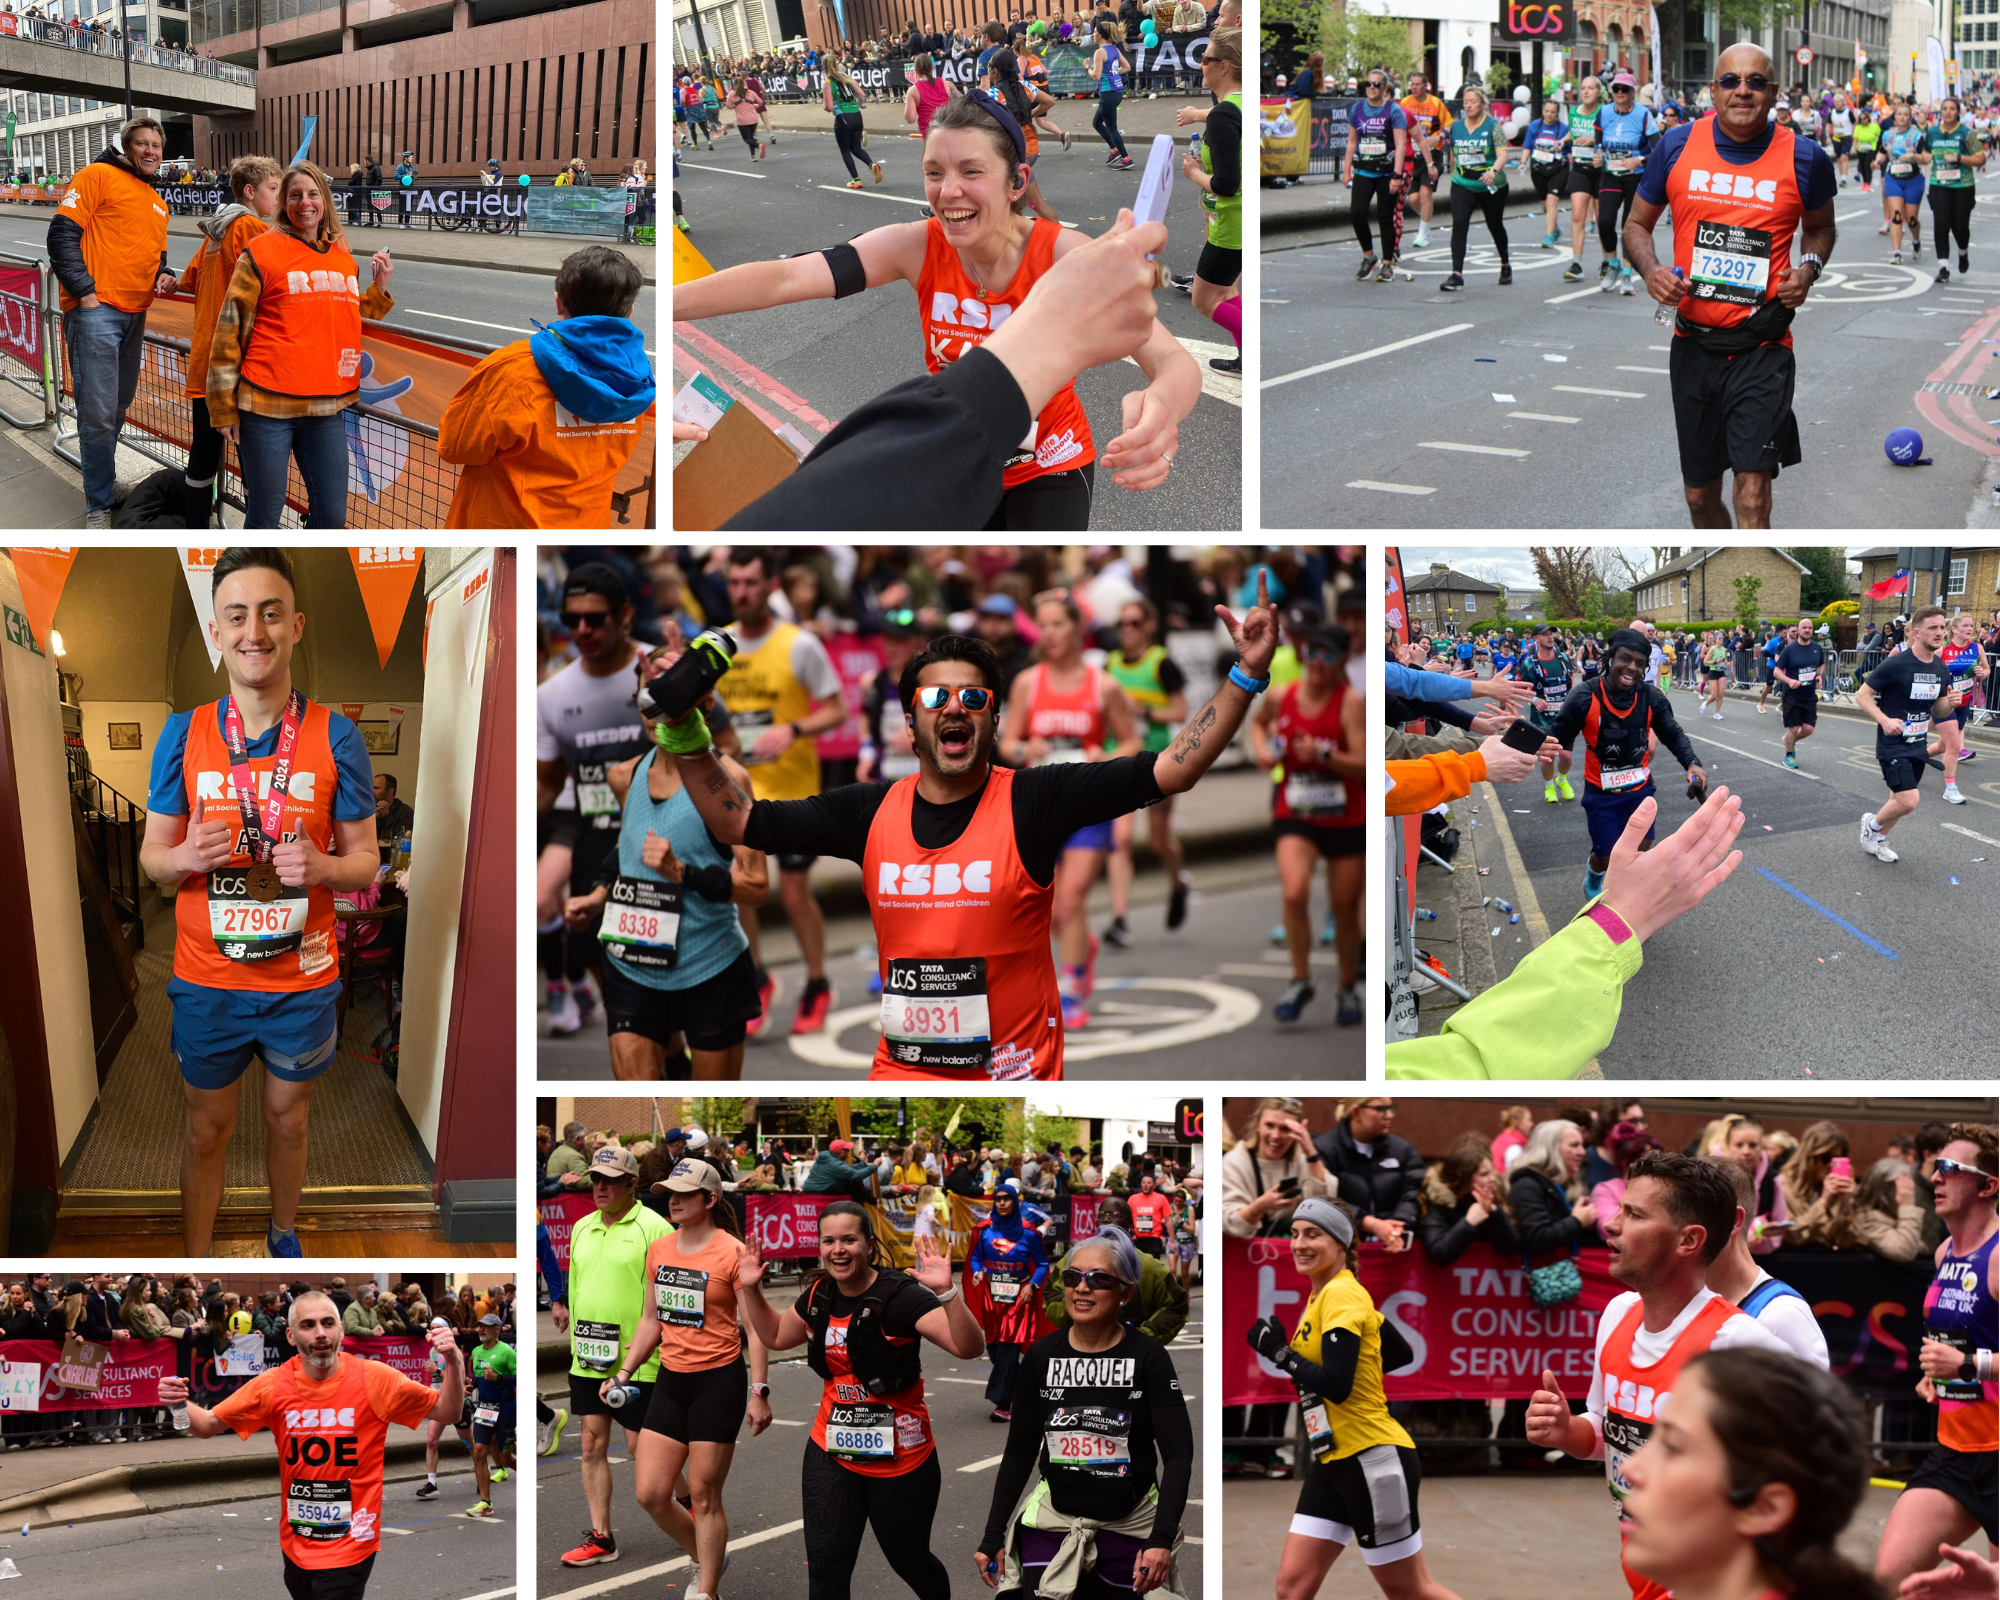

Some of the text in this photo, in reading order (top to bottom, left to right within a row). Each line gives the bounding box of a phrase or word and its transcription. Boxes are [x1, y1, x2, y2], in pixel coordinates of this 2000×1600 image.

[1508, 0, 1563, 34] tcs
[1800, 52, 1811, 60] 20
[1688, 169, 1778, 203] RSBC
[1702, 196, 1724, 205] Society
[1733, 200, 1748, 208] Blind
[1749, 202, 1773, 211] Children
[1698, 225, 1725, 246] tcs
[1728, 236, 1766, 248] CONSULTANCY
[1729, 230, 1746, 238] TATA
[1726, 242, 1752, 251] SERVICES
[1702, 256, 1756, 281] 73297
[1729, 294, 1757, 304] balance
[930, 325, 979, 342] Royal Society
[359, 547, 416, 564] RSBC
[464, 568, 489, 600] RSBC
[1914, 692, 1937, 700] sense
[1907, 713, 1920, 722] tcs
[231, 725, 241, 755] FINISHER
[575, 725, 642, 748] FREDDY
[274, 758, 290, 790] 2024
[1609, 772, 1638, 786] 15961
[242, 786, 254, 818] FINISHER
[212, 872, 247, 895] tcs
[878, 860, 992, 896] RSBC
[612, 879, 635, 902] tcs
[637, 882, 654, 892] TATA
[636, 890, 676, 902] CONSULTANCY
[892, 900, 990, 910] Society for Blind Children
[224, 908, 292, 932] 27967
[618, 912, 658, 938] 8338
[246, 950, 264, 959] new
[302, 946, 326, 959] Limits
[639, 955, 668, 966] balance
[891, 968, 917, 990] tcs
[920, 972, 978, 982] CONSULTANCY
[920, 982, 958, 991] SERVICES
[902, 1006, 960, 1034] 8931
[922, 1055, 942, 1064] new
[1150, 1126, 1160, 1134] THE
[794, 1204, 816, 1217] TATA
[1074, 1202, 1094, 1235] tcs
[754, 1206, 795, 1250] tcs
[658, 1270, 676, 1283] tcs
[676, 1275, 704, 1284] CONSULTANCY
[1938, 1263, 1972, 1282] MATT
[660, 1290, 695, 1309] 38118
[1938, 1300, 1974, 1314] LUNG UK
[678, 1318, 698, 1326] balance
[80, 1345, 94, 1362] GO
[230, 1350, 256, 1361] Jodie
[387, 1345, 410, 1356] TATA
[577, 1342, 610, 1358] 38119
[1450, 1347, 1597, 1378] SERVICES
[59, 1364, 100, 1388] CHARLENE
[1051, 1358, 1132, 1387] RACQUEL
[1954, 1392, 1977, 1400] balance
[285, 1408, 354, 1428] RSBC
[832, 1407, 852, 1424] tcs
[1082, 1421, 1108, 1430] SERVICES
[1604, 1418, 1627, 1445] tcs
[836, 1431, 884, 1449] 68886
[1060, 1436, 1116, 1457] 28519
[285, 1436, 358, 1467] JOE
[290, 1483, 312, 1498] tcs
[298, 1504, 341, 1520] 55942
